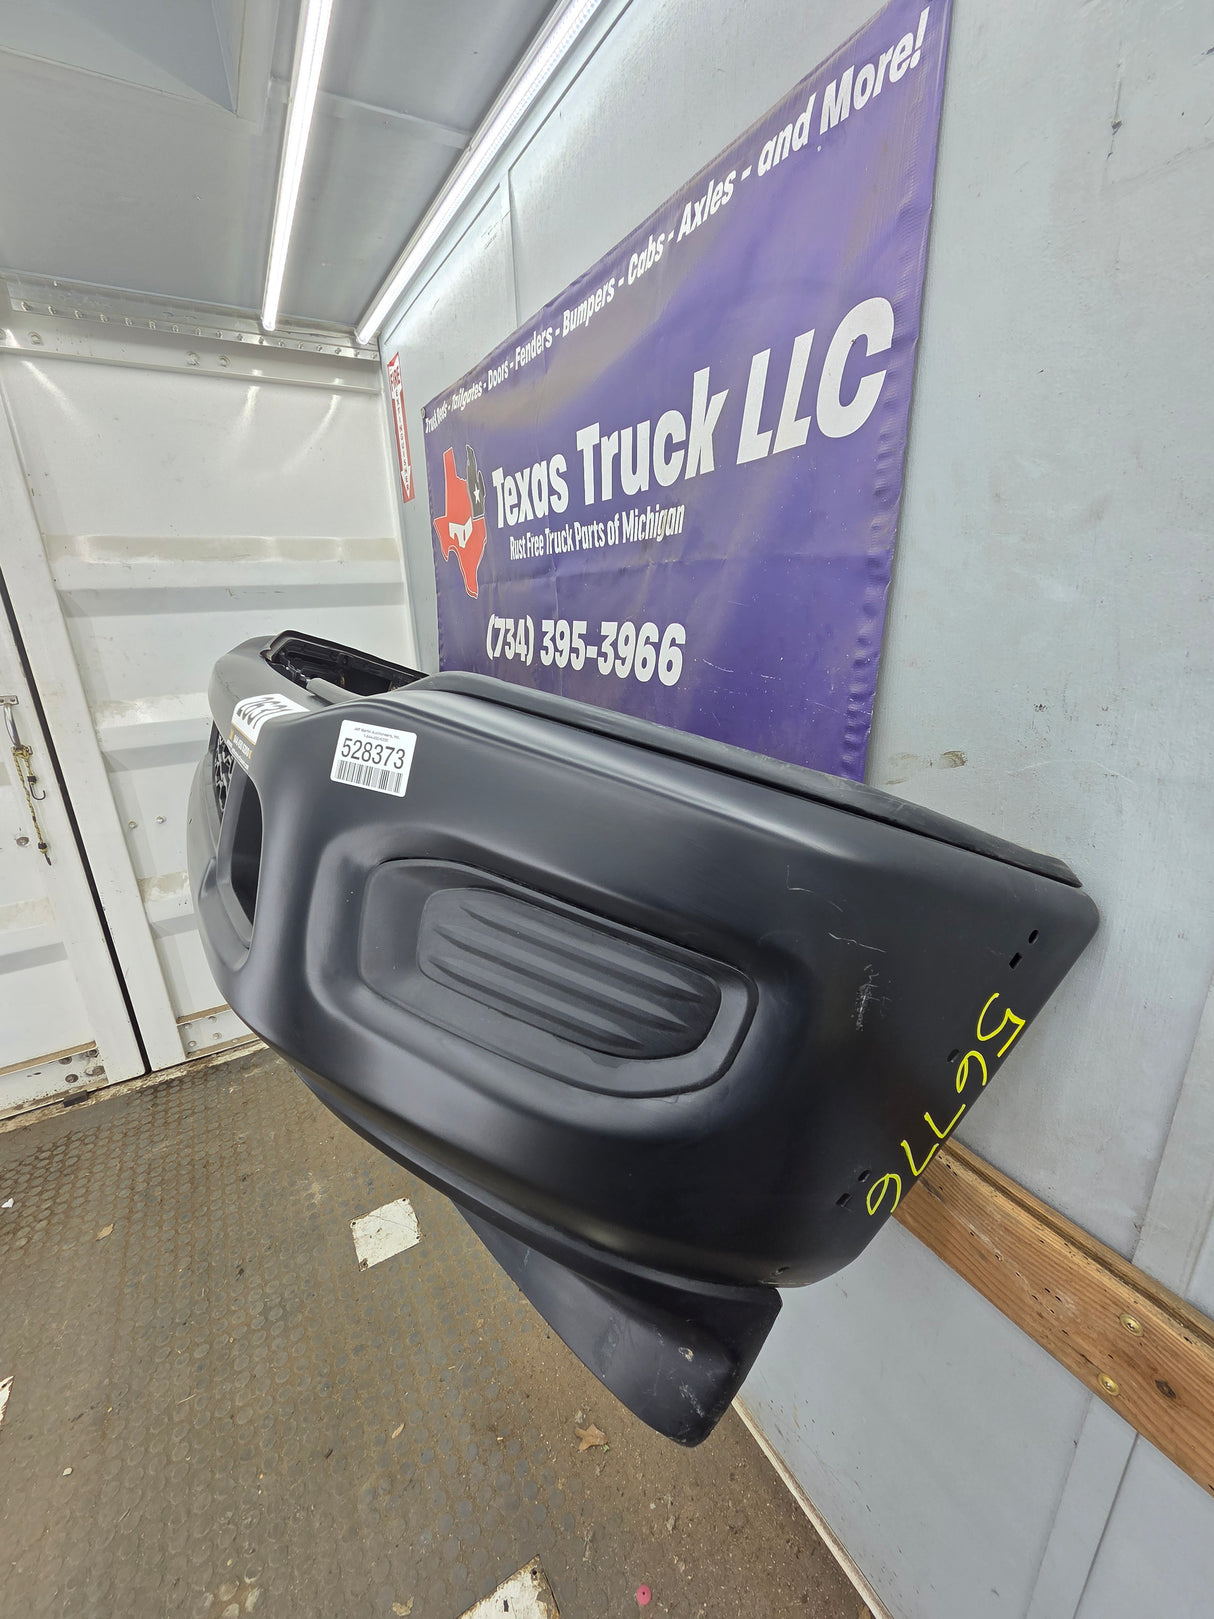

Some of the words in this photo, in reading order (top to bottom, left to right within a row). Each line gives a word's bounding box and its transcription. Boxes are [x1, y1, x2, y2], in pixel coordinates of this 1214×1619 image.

[451, 381, 483, 411] Tailgates
[488, 360, 509, 391] Doors
[515, 326, 553, 371] Fenders
[562, 277, 616, 338] Bumpers
[628, 232, 664, 286] Cabs
[678, 169, 737, 243] Axles
[757, 92, 816, 177] and
[820, 6, 931, 136] More!
[492, 453, 569, 529] Texas
[576, 366, 730, 506] Truck
[736, 297, 895, 465] LLC
[509, 534, 526, 561] Rust
[526, 531, 545, 558] Free
[545, 523, 574, 554] Truck
[574, 518, 605, 551] Parts
[607, 513, 620, 546] of
[622, 505, 685, 544] Michigan
[486, 614, 534, 666] (734)
[540, 619, 686, 687] 395-3966
[341, 737, 406, 769] 528373
[866, 992, 1026, 1216] 56776
